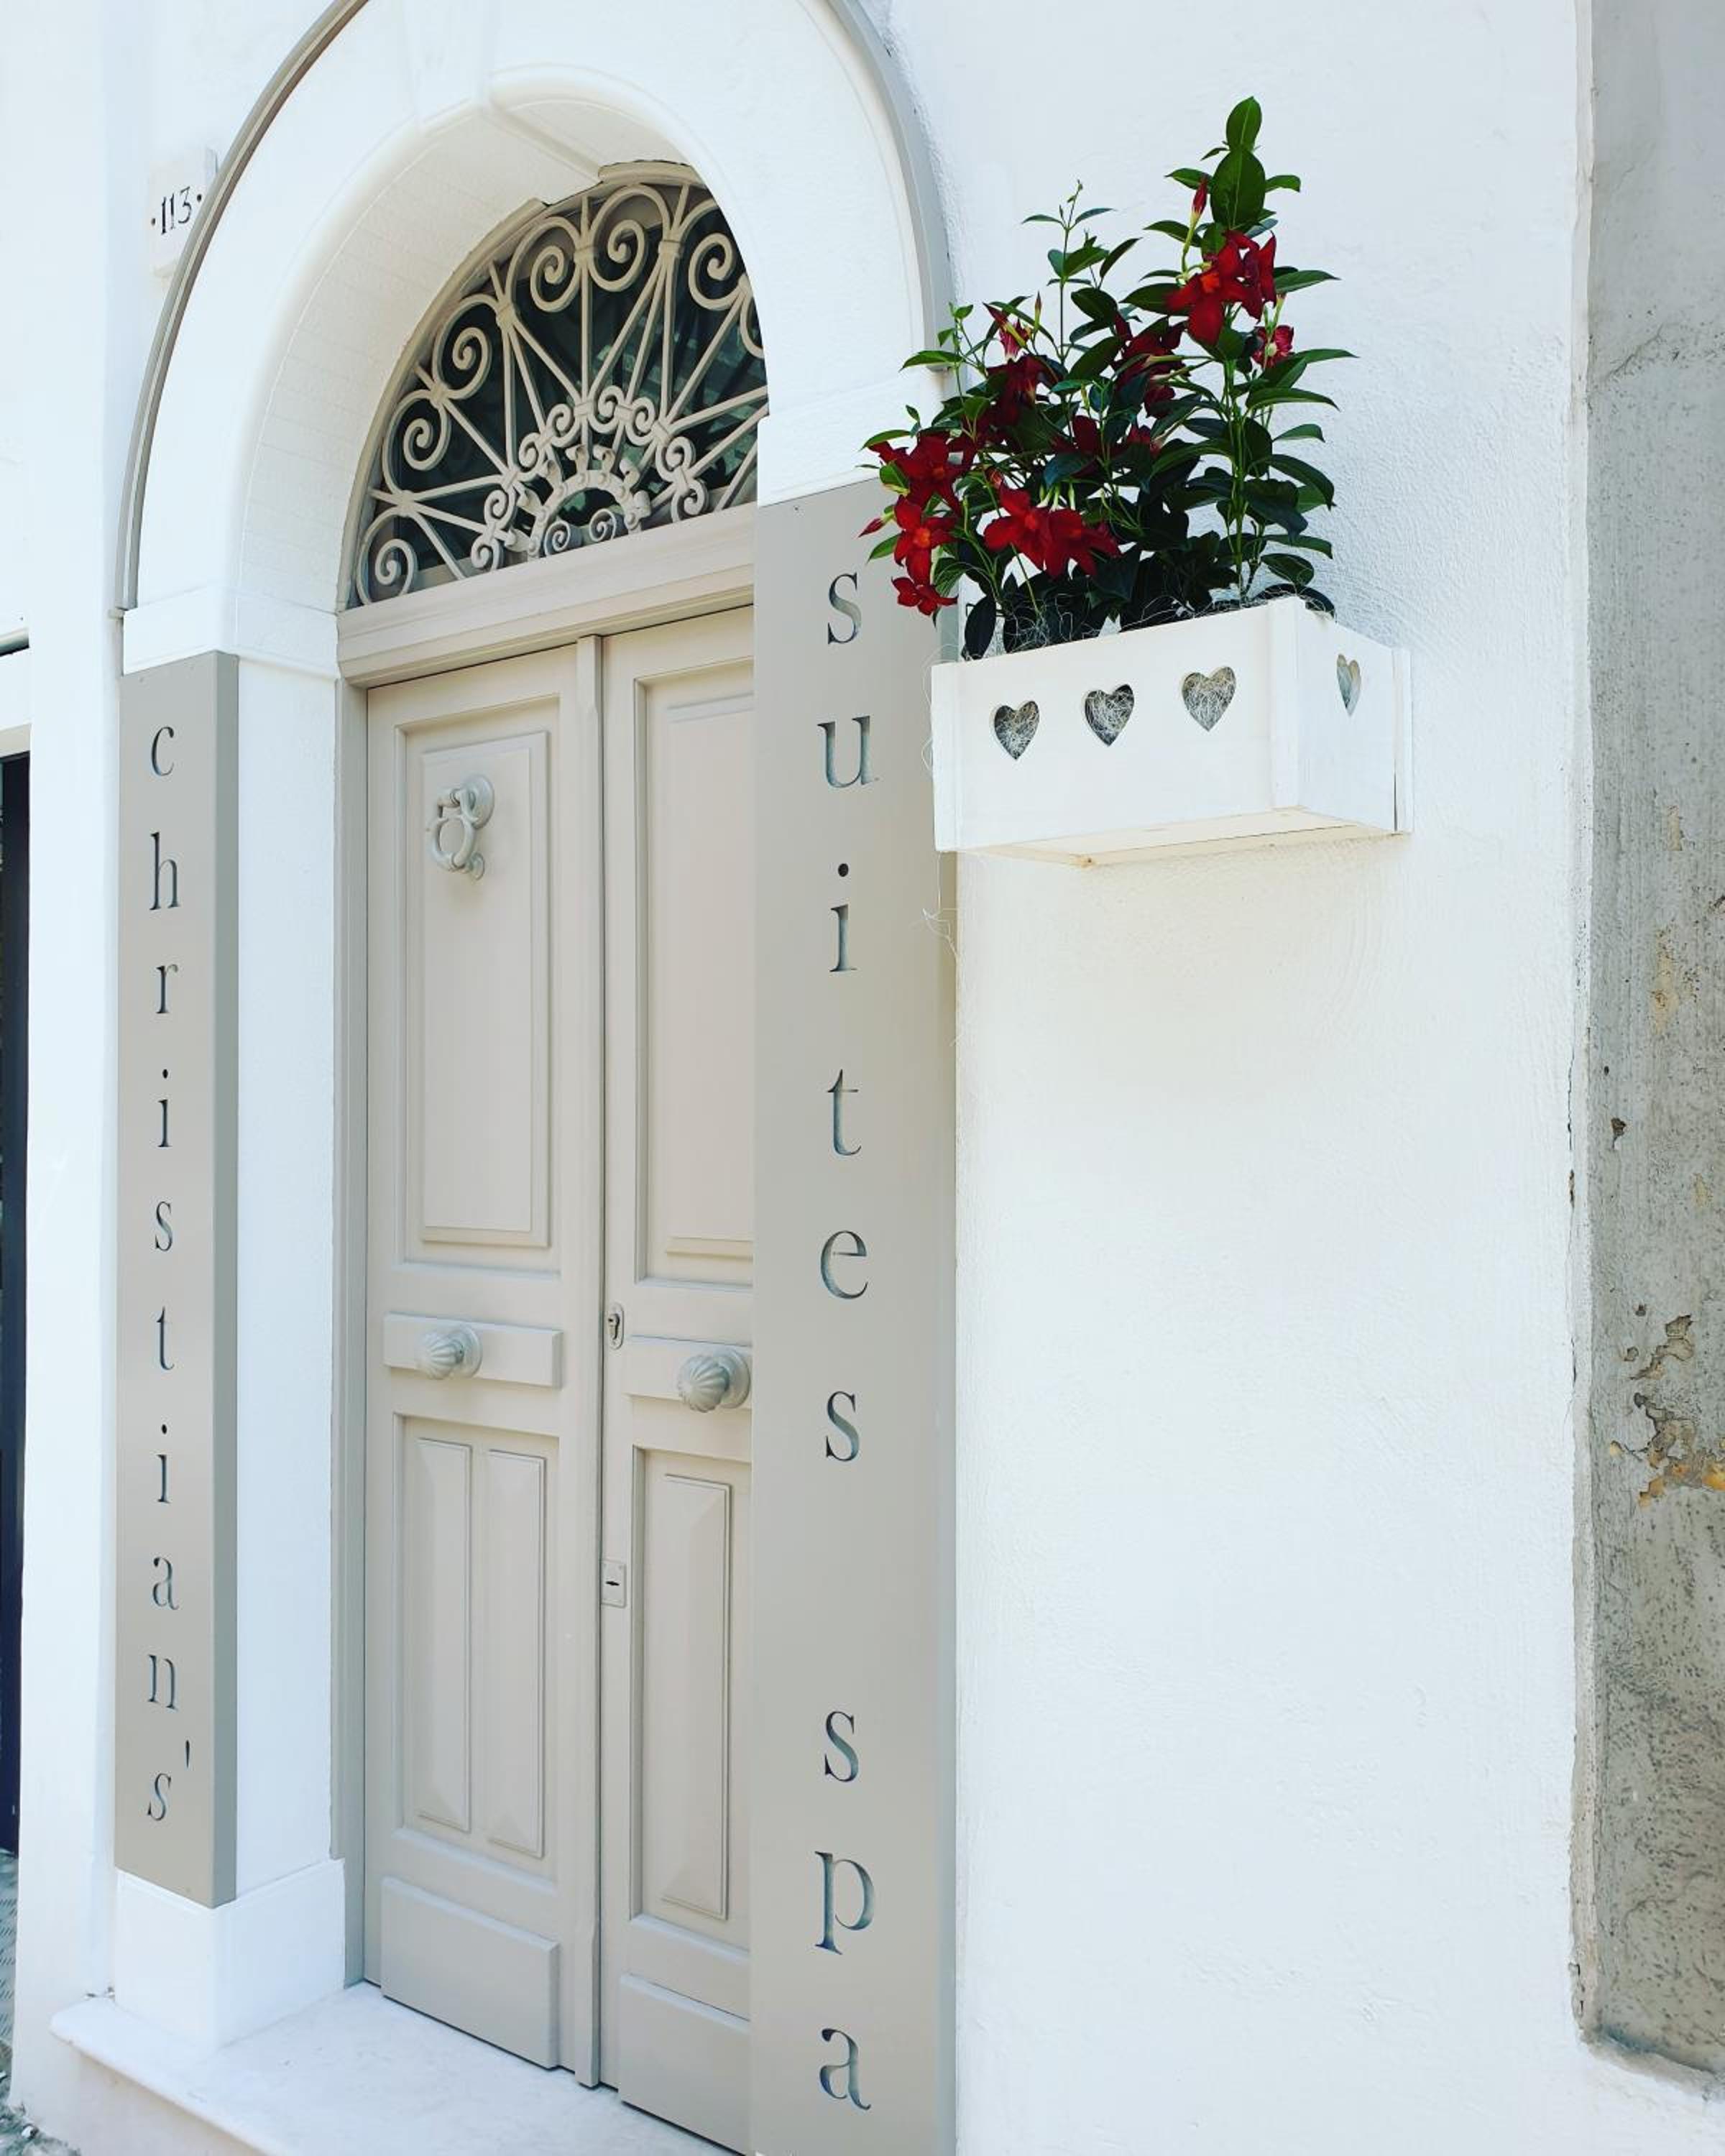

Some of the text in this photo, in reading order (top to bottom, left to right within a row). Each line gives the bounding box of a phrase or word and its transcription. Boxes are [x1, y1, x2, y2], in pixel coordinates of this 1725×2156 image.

[147, 724, 190, 1822] christian's
[814, 572, 876, 2111] suites spa
